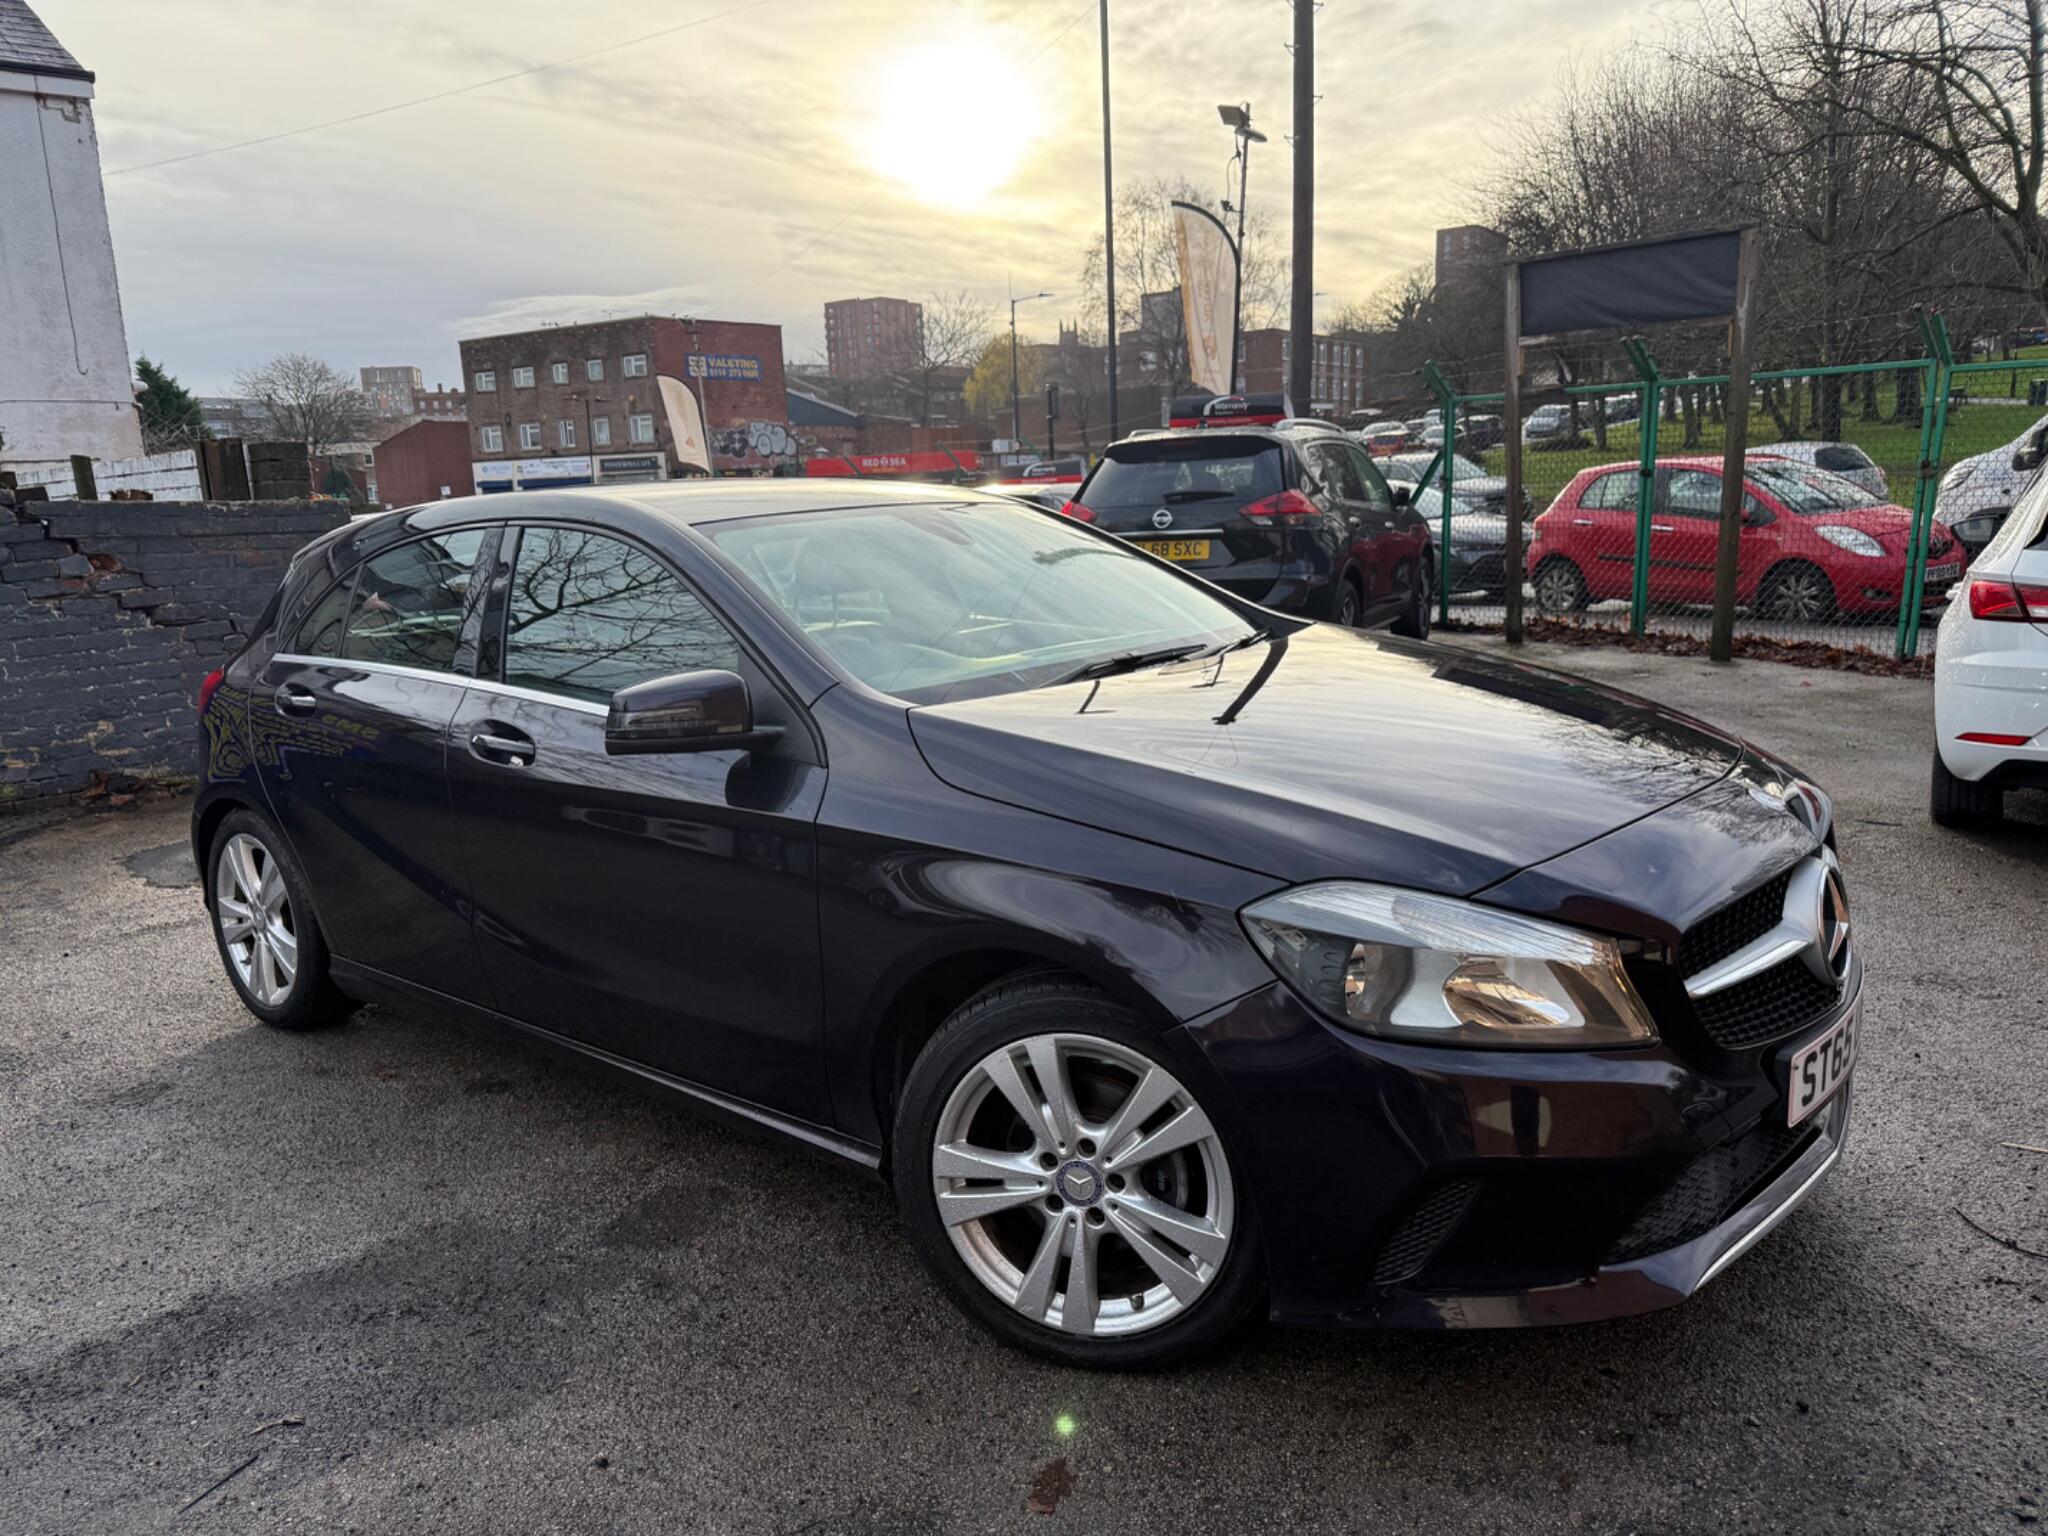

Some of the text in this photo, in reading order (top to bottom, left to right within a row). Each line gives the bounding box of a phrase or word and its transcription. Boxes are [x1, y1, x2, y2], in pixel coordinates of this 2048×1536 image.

[708, 357, 758, 369] VALETING
[862, 456, 907, 467] RED SEA
[1173, 542, 1203, 556] SXC
